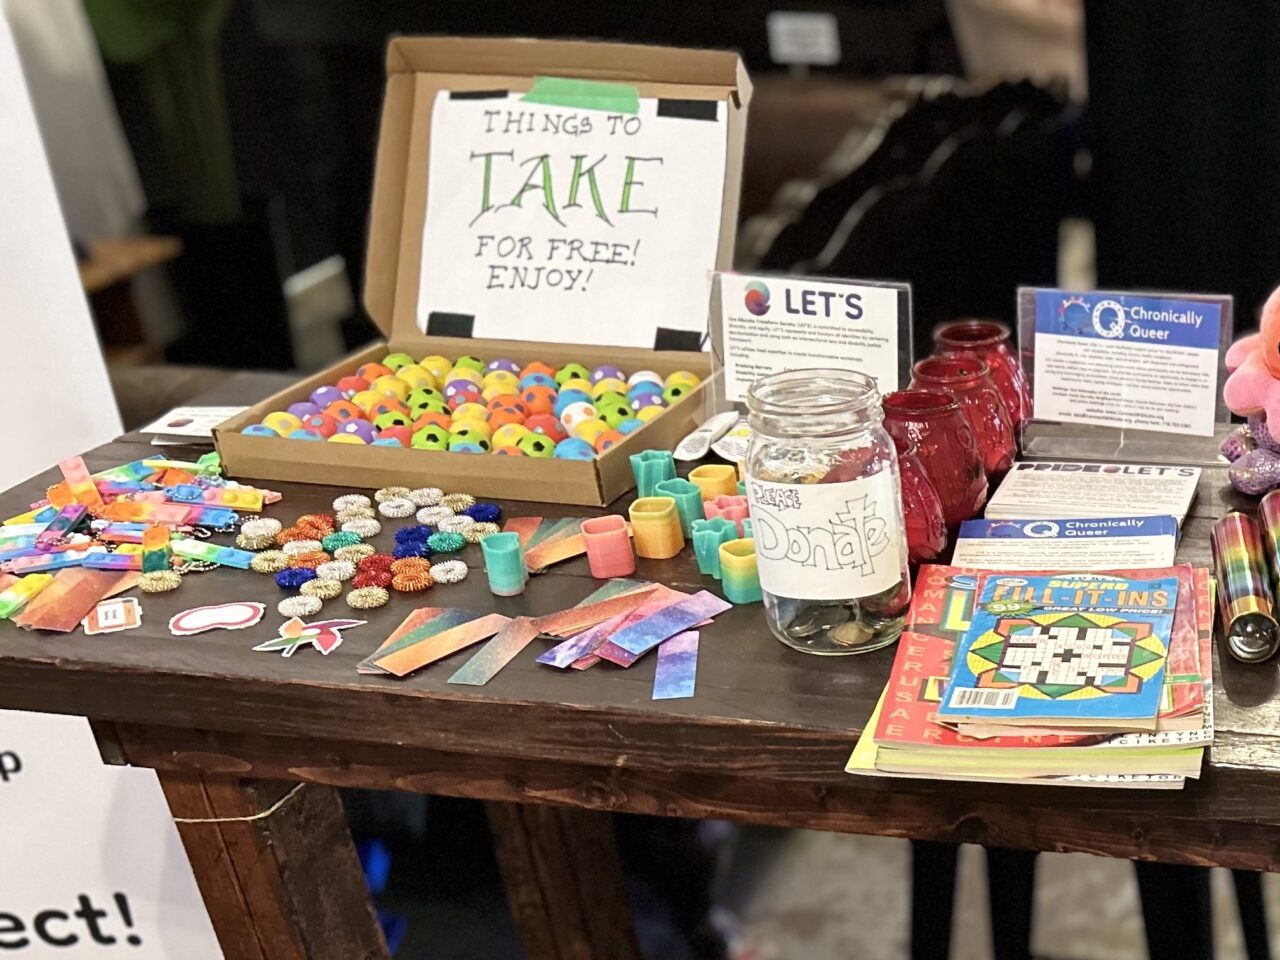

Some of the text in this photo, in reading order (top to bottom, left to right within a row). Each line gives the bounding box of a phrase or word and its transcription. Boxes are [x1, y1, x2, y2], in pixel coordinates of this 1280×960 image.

[484, 110, 642, 136] THINGS TO
[469, 149, 664, 228] TAKE
[475, 236, 640, 266] FOR FREE!
[486, 265, 594, 292] ENJOY!
[786, 288, 863, 320] LET'S
[1130, 306, 1204, 327] Chronically
[1130, 326, 1170, 340] Queer
[1122, 466, 1196, 477] LET'S
[752, 482, 802, 512] PLEASE
[752, 494, 890, 577] Donate
[1064, 528, 1108, 536] Queer
[1066, 519, 1144, 529] Chronically
[1048, 580, 1129, 590] SUPERB
